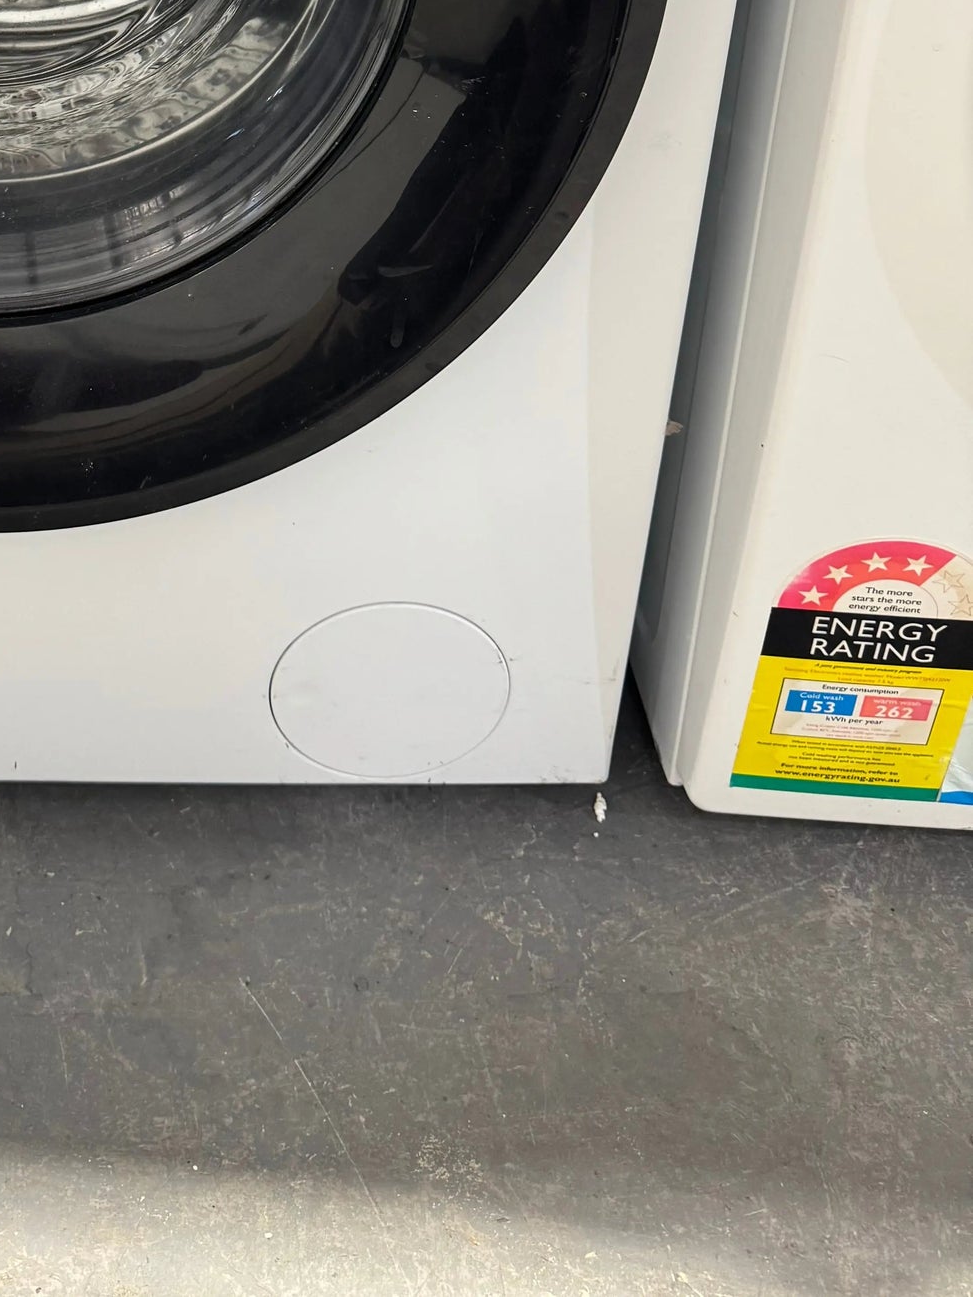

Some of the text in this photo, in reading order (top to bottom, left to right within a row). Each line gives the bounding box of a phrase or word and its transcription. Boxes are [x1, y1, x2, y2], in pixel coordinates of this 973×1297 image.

[865, 586, 913, 597] The more
[877, 596, 890, 604] the
[895, 598, 922, 606] more
[848, 604, 921, 614] energy efficient
[811, 616, 948, 642] ENERGY
[809, 638, 936, 663] RATING
[822, 684, 899, 695] Energy consumption
[800, 691, 820, 700] Cold
[800, 699, 836, 714] 153
[875, 705, 913, 719] 262
[825, 715, 846, 724] kWh
